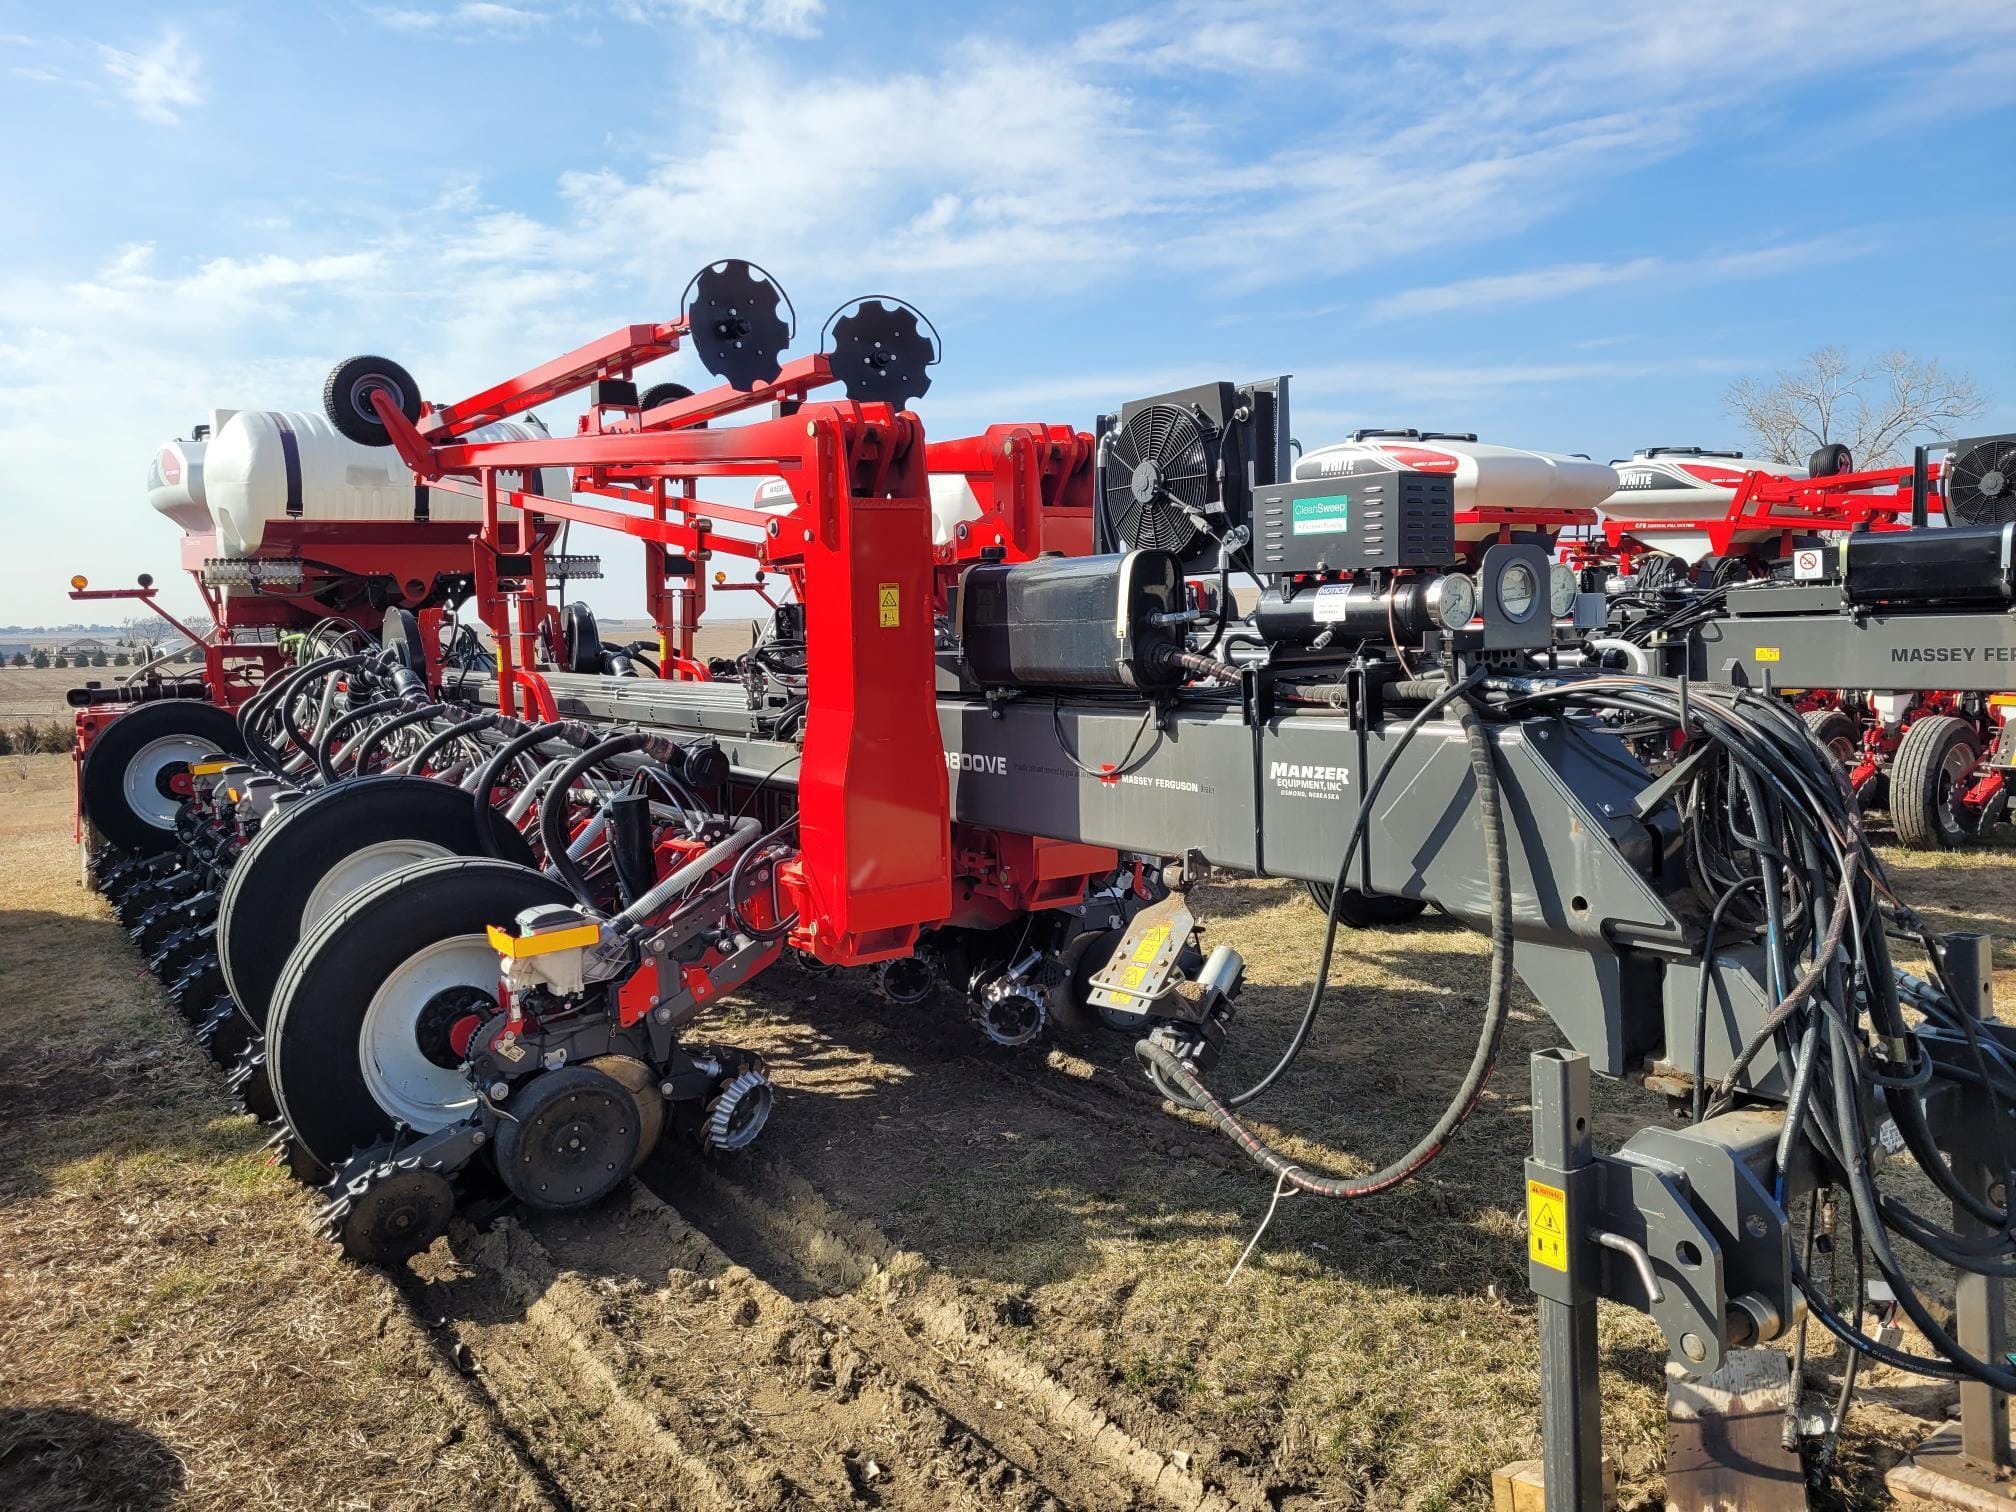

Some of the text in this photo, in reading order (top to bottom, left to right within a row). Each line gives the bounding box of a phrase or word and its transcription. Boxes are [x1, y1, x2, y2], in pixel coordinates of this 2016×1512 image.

[1320, 459, 1354, 472] WHITE
[1618, 472, 1652, 486] WHITE
[1295, 503, 1345, 516] CleanSweep
[1320, 586, 1348, 595] NOTICE
[1891, 647, 1976, 662] MASSEY
[1270, 761, 1349, 784] MANZER
[1121, 775, 1153, 787] MASSEY
[1155, 778, 1198, 792] FERGUSON
[1280, 790, 1340, 800] OSMOND, NEBRASKA
